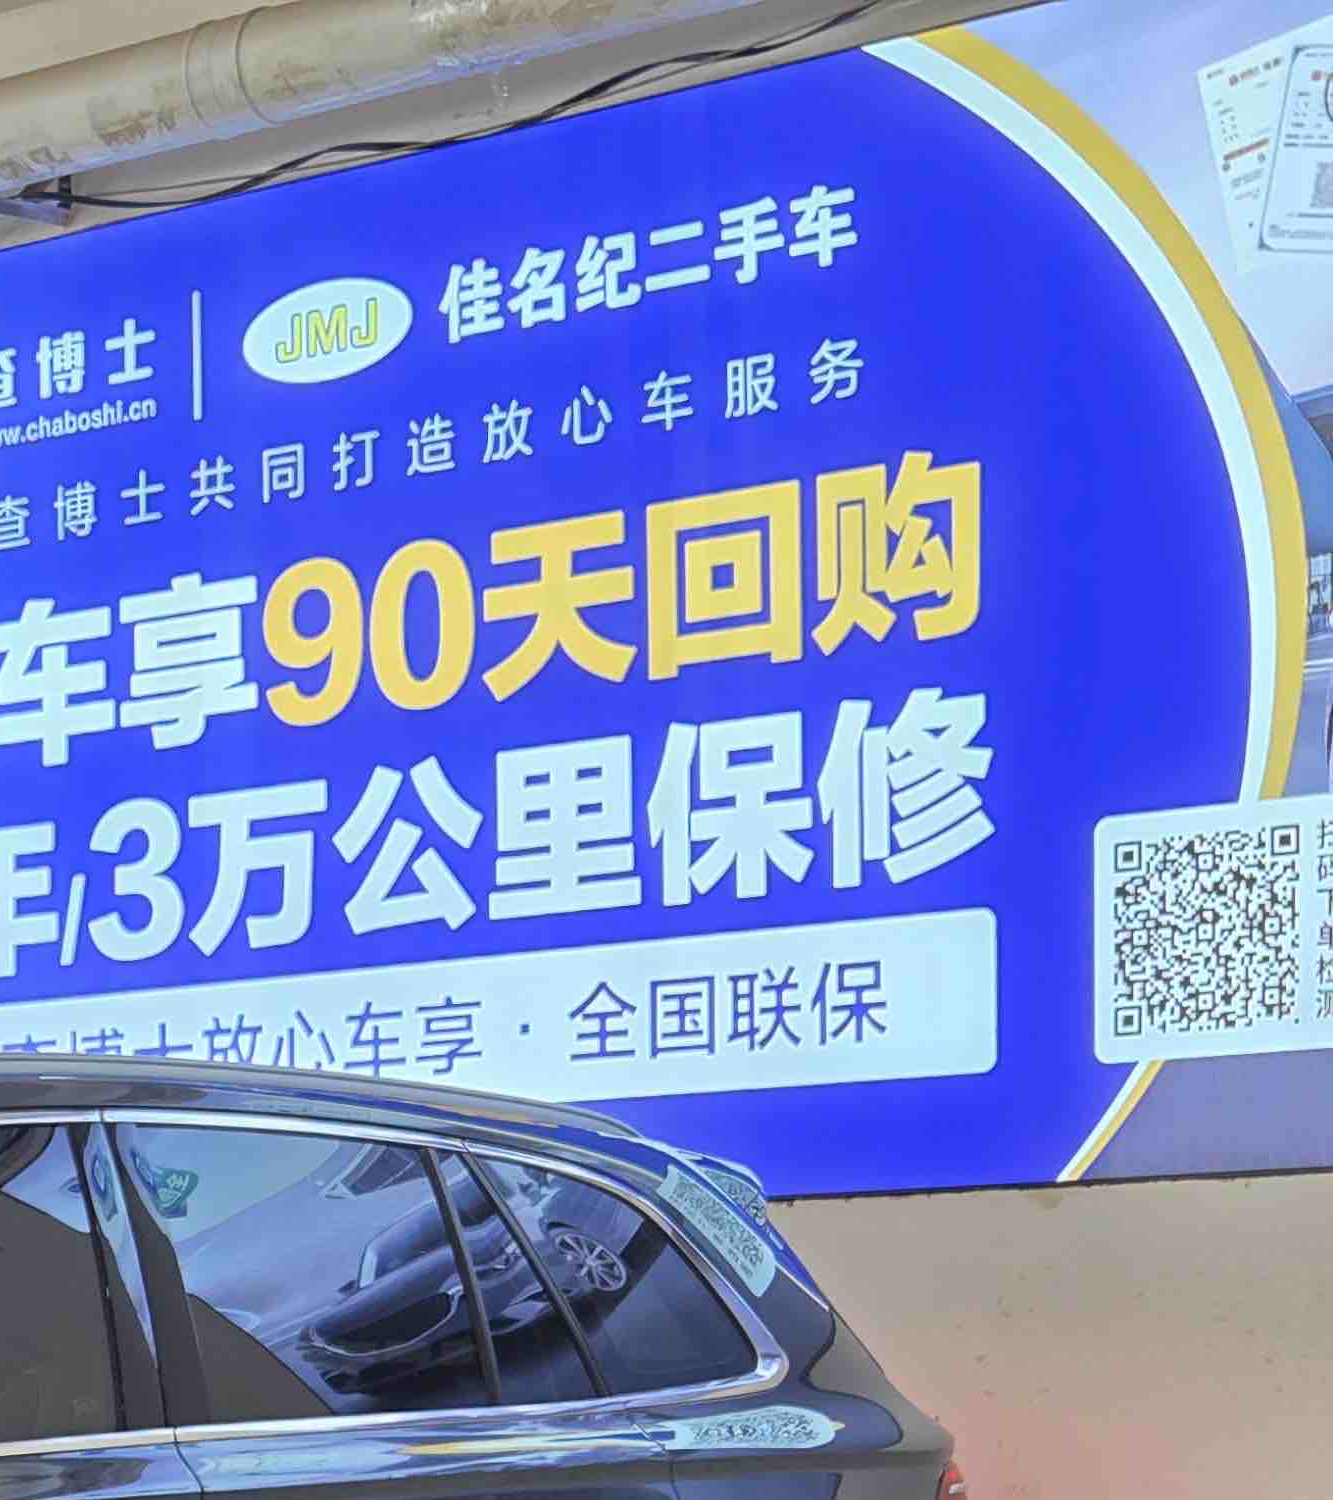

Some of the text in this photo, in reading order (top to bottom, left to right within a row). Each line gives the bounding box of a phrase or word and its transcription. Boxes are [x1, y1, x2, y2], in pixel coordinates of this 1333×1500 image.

[438, 184, 859, 345] 佳名纪二手车
[275, 298, 380, 364] JMJ
